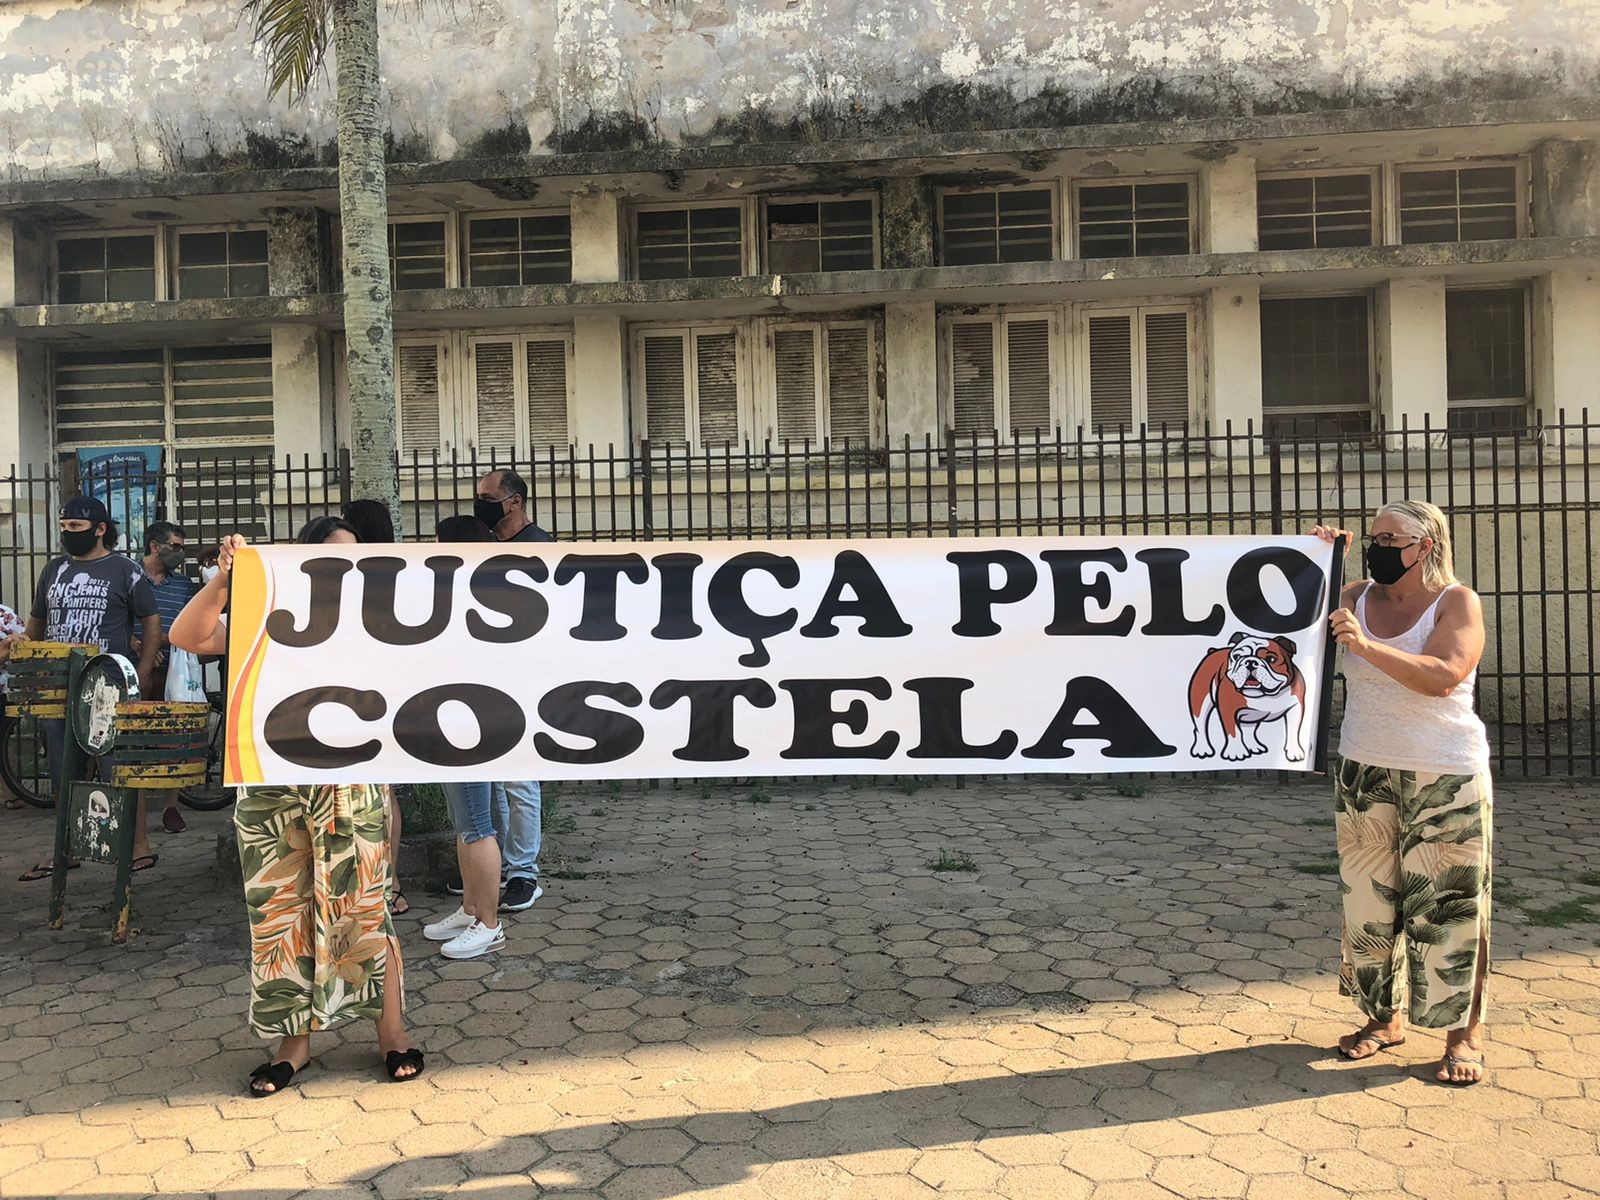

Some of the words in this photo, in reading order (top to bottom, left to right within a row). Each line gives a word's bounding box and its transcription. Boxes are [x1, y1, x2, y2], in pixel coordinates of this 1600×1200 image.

[48, 597, 60, 608] THE
[62, 597, 108, 610] PANTHERS
[265, 549, 913, 667] JUSTIÇA
[946, 546, 1325, 637] PELO
[47, 624, 67, 637] SINCE
[67, 623, 99, 640] 1976
[264, 676, 1177, 768] COSTELA
